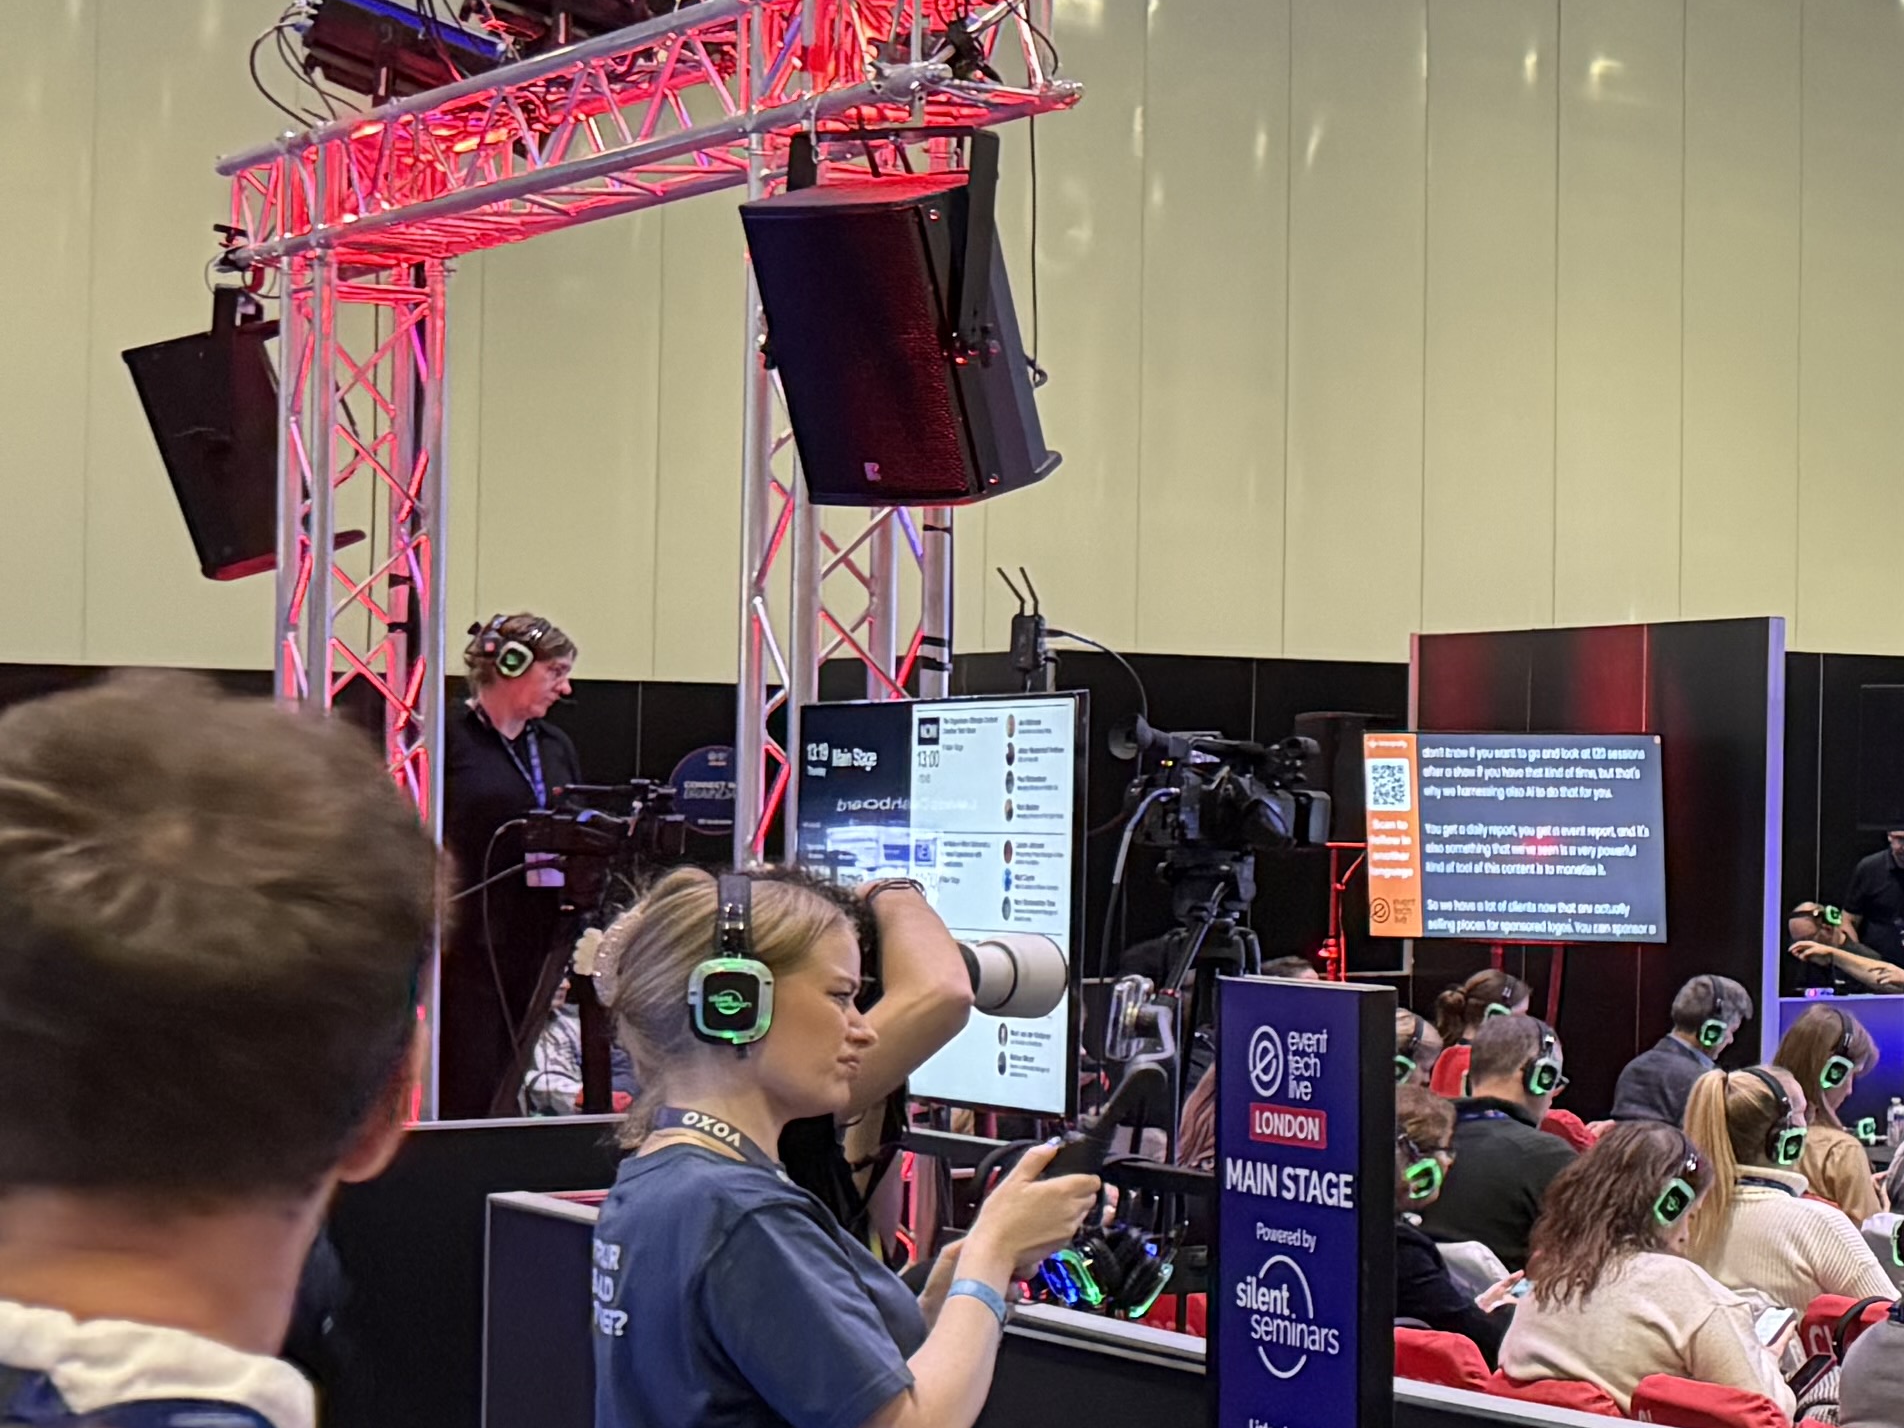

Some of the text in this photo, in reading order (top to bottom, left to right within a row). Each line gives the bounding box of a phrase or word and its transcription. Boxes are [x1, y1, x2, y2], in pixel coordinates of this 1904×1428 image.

[1287, 1028, 1328, 1054] event
[1287, 1052, 1321, 1078] tech
[1287, 1075, 1312, 1101] live
[1255, 1110, 1320, 1141] LONDON
[1225, 1157, 1354, 1208] MAIN STAGE
[1256, 1221, 1316, 1252] Powered by
[1236, 1275, 1290, 1316] silent
[1250, 1312, 1339, 1355] seminars
